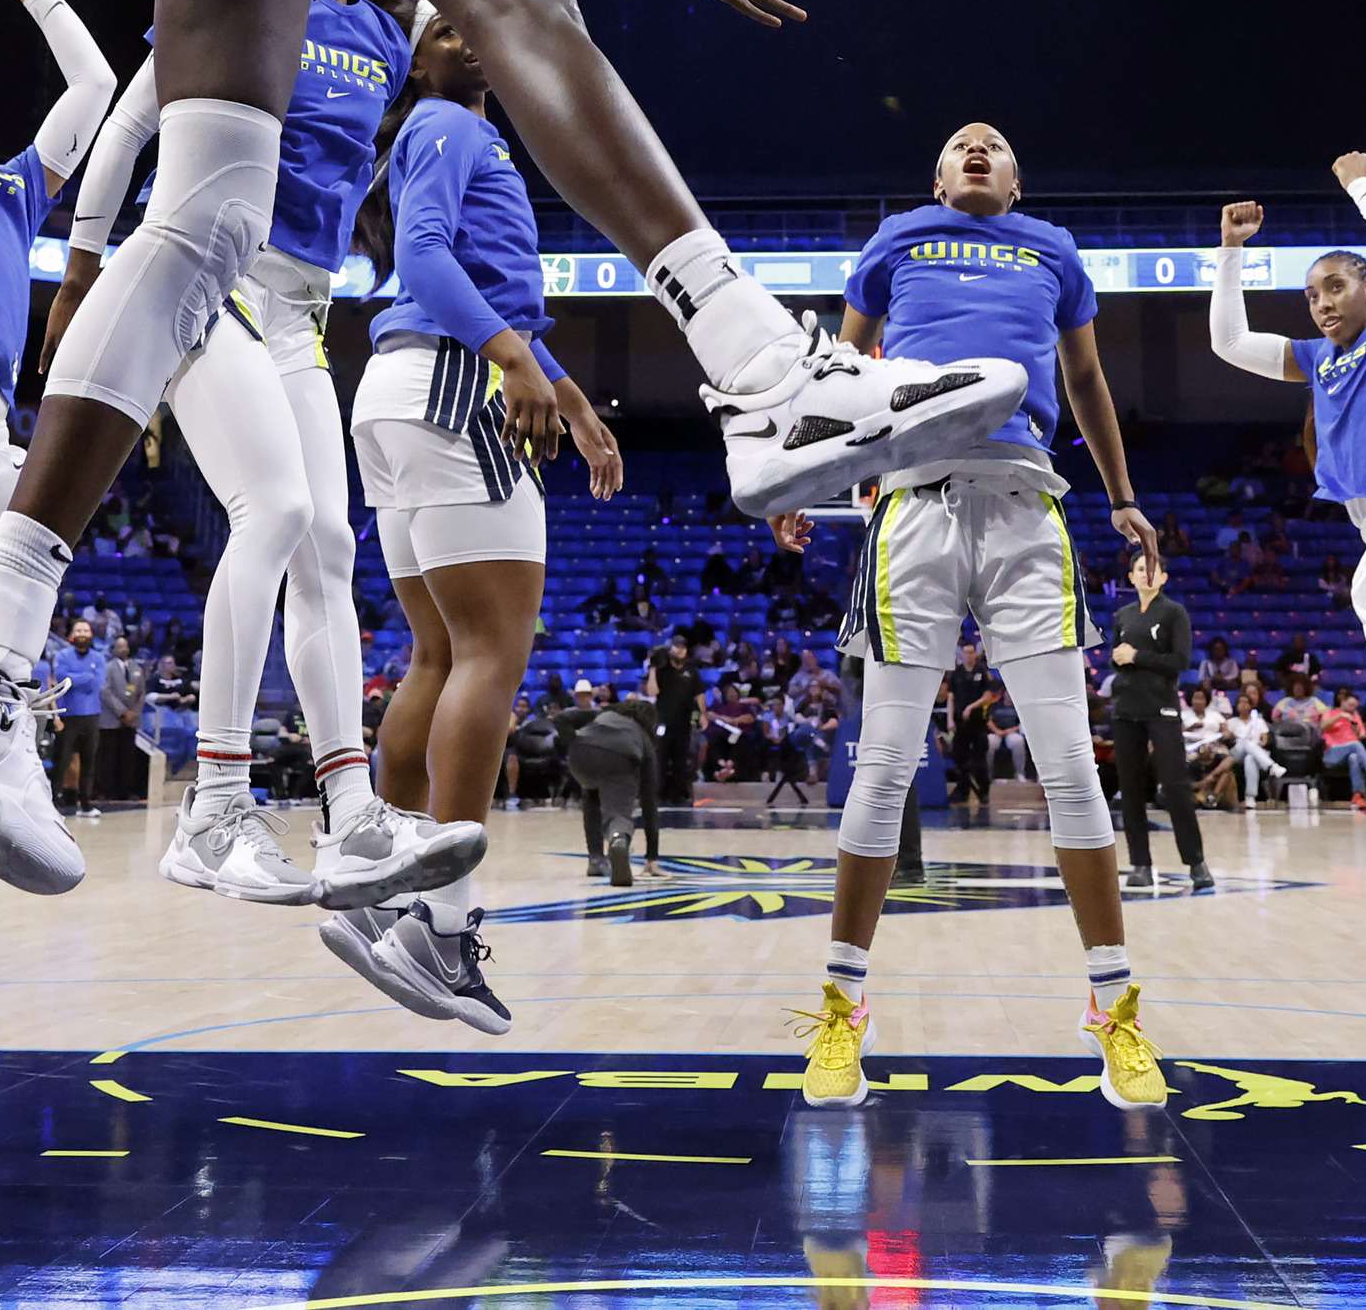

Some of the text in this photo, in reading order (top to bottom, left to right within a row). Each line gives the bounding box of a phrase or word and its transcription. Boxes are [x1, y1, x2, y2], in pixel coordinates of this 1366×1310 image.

[300, 61, 376, 92] DALLAS
[910, 241, 1041, 267] WINGS
[596, 261, 617, 290] 0
[1155, 257, 1176, 285] 0
[395, 1068, 1182, 1093] WNBA
